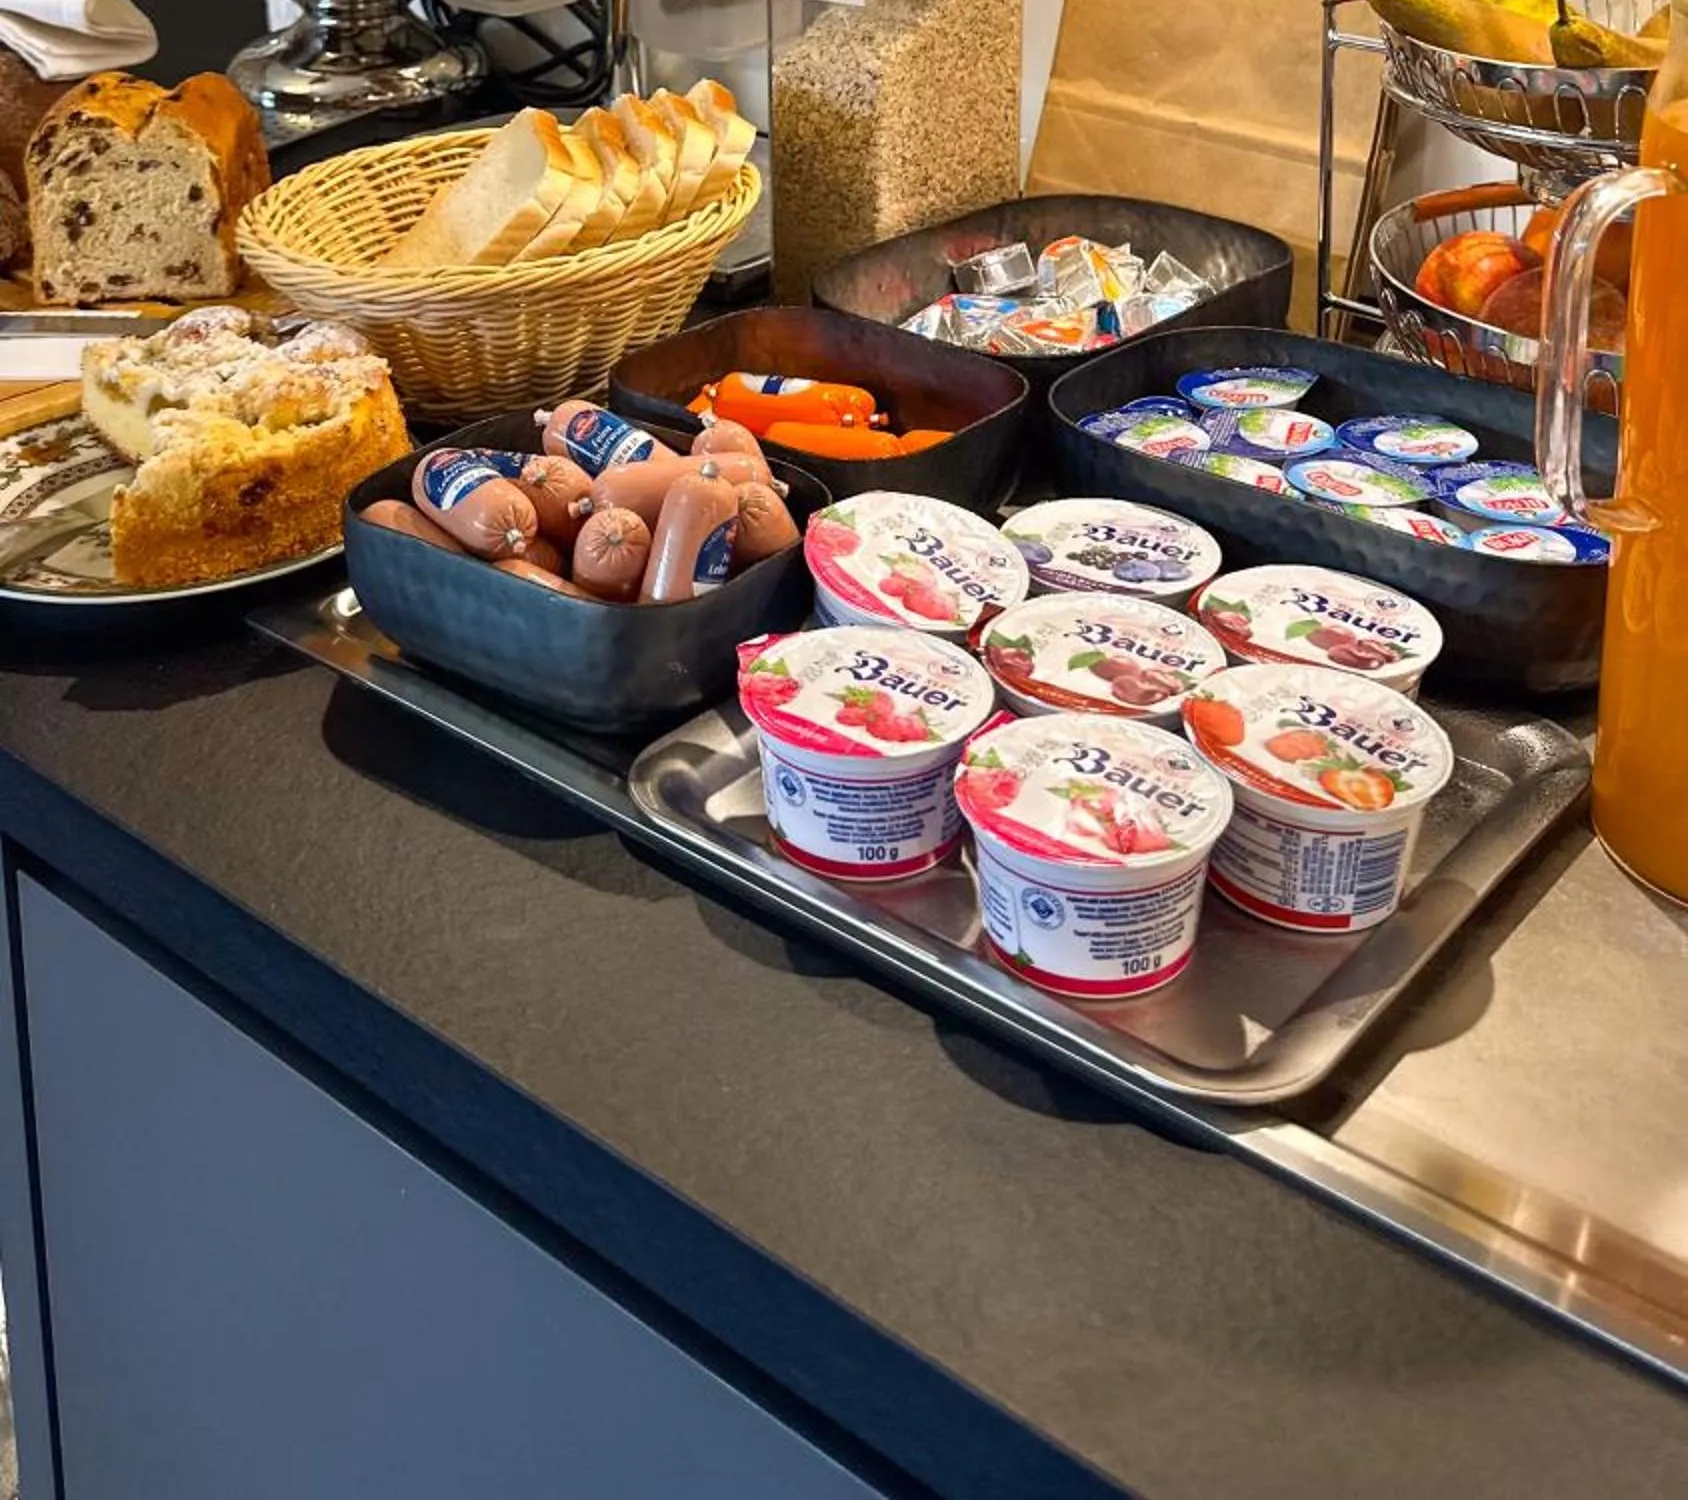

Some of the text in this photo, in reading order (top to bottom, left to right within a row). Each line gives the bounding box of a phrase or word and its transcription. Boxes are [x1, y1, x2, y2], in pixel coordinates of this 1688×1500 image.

[895, 527, 1000, 602] Bauer
[1072, 523, 1200, 561] Bauer
[1279, 587, 1421, 643] Bauer
[1063, 619, 1206, 672] Bauer
[834, 650, 968, 711] Bauer
[1280, 695, 1429, 773] Bauer
[1053, 741, 1207, 817] Bauer
[857, 845, 899, 861] 100 g
[1122, 955, 1162, 975] 100 g
